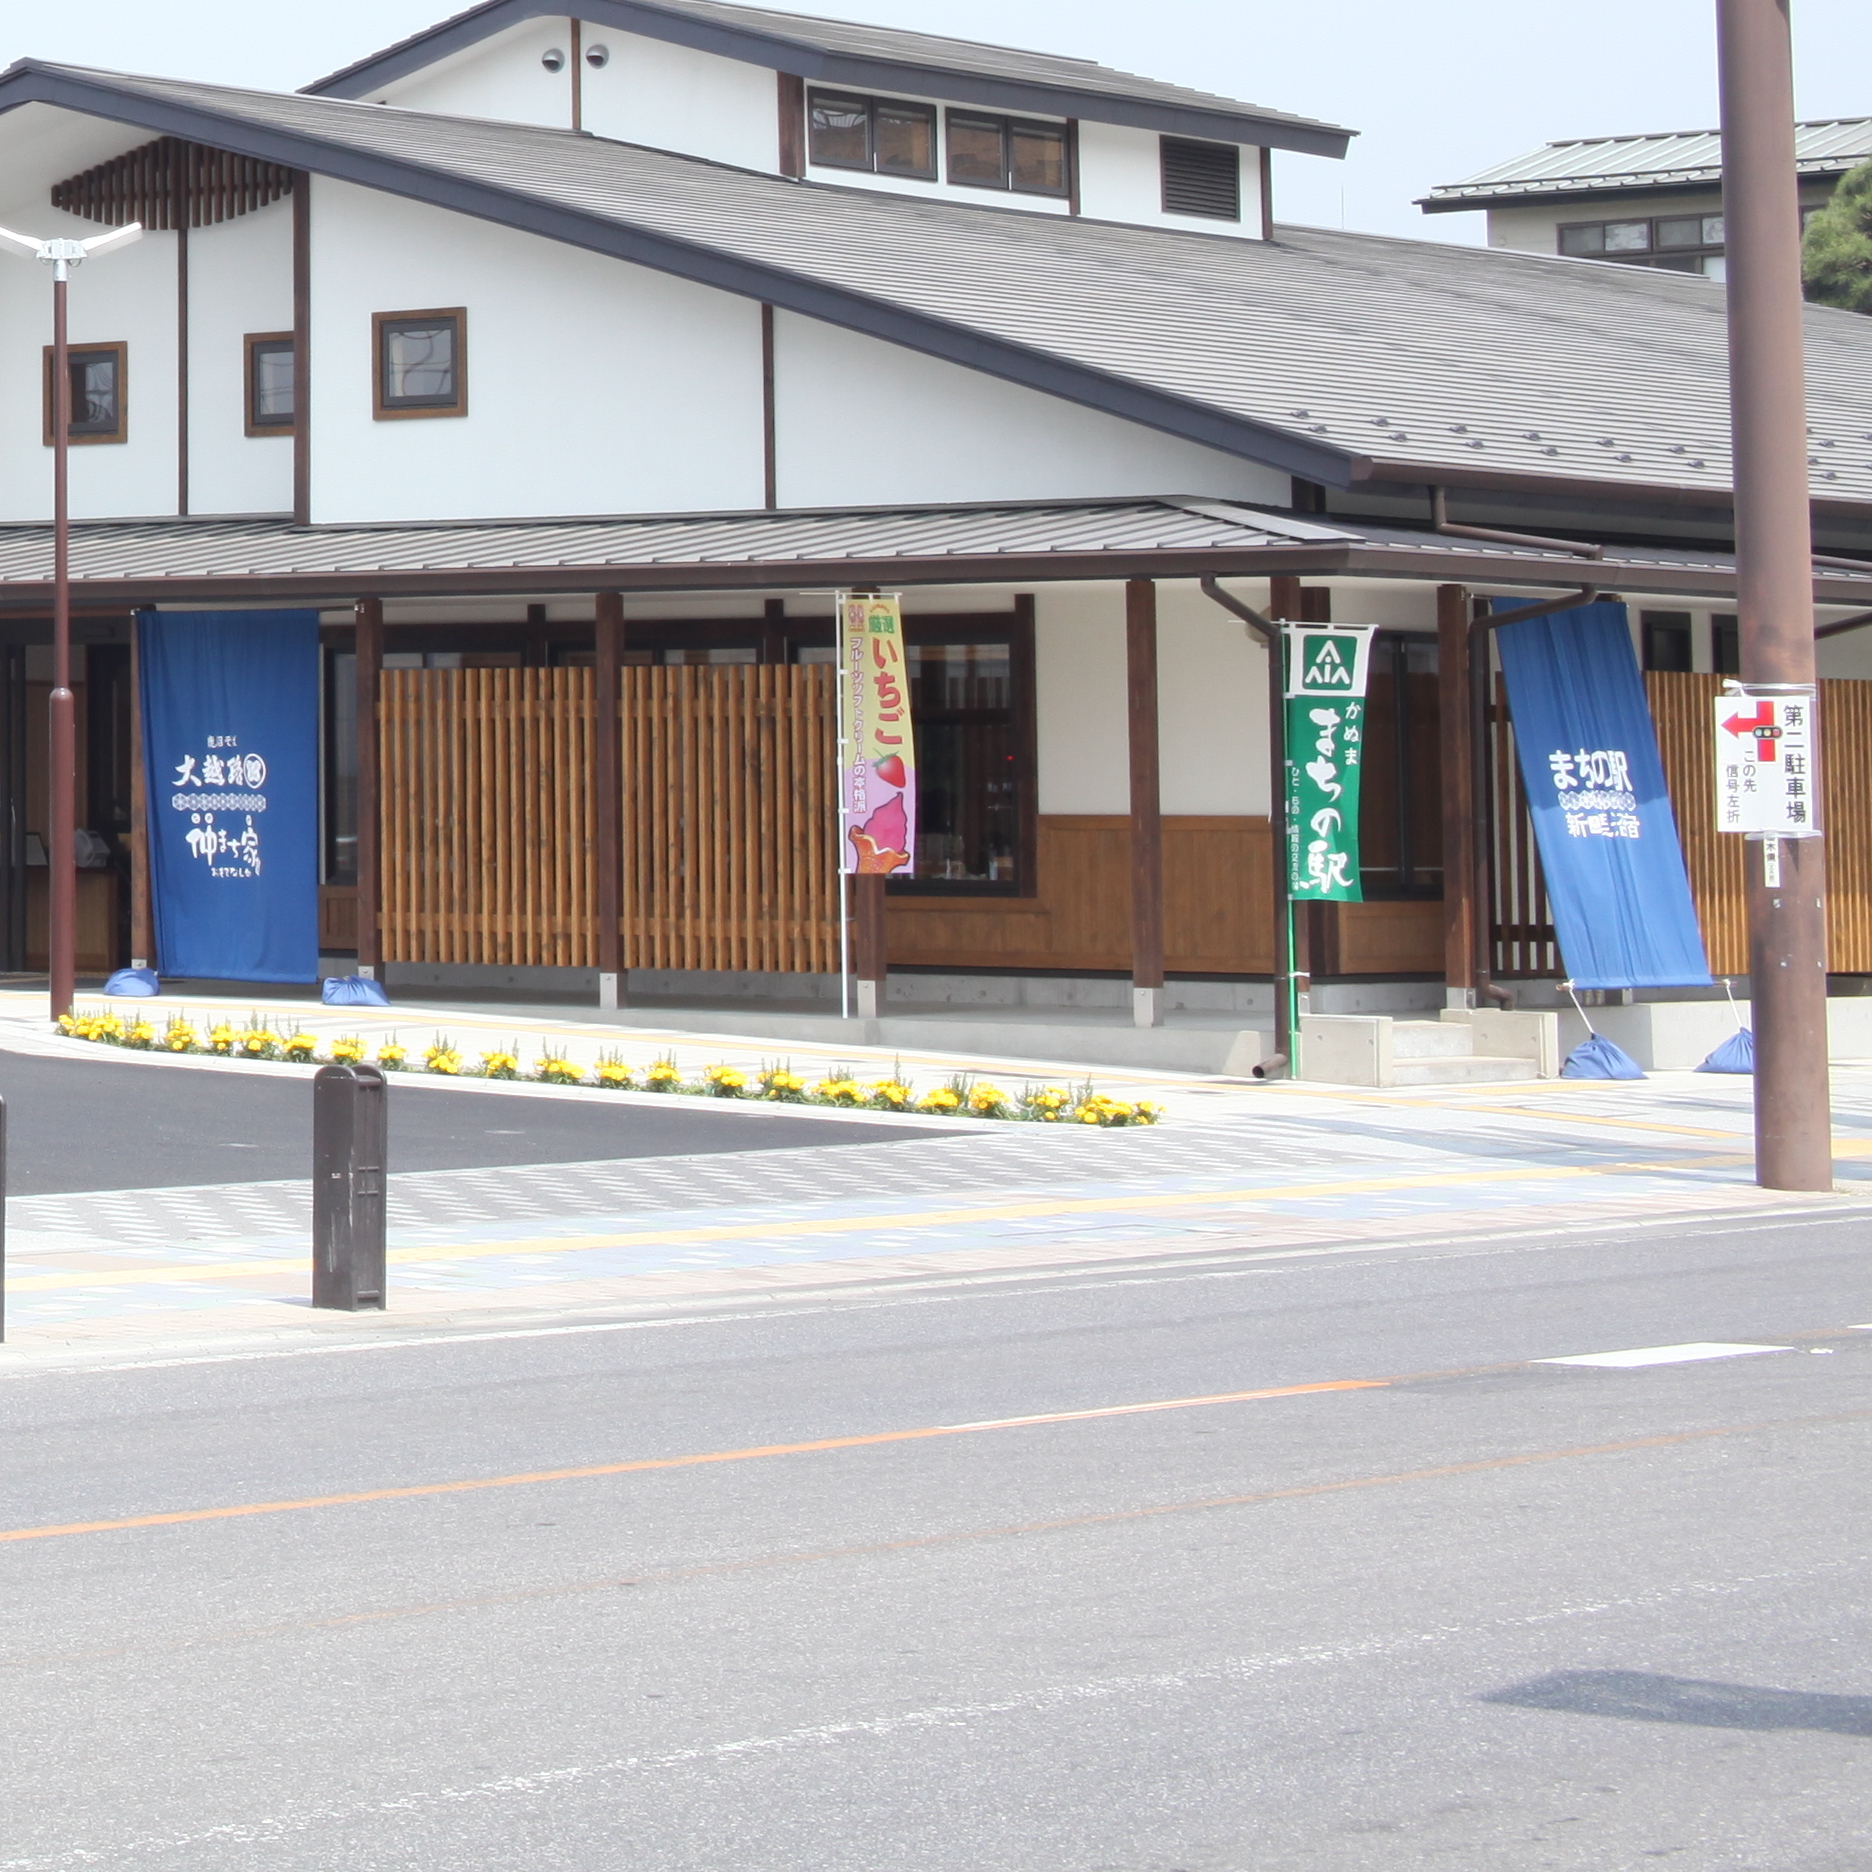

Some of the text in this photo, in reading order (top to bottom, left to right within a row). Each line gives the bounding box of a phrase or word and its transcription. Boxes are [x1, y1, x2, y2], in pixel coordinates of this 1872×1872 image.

[850, 636, 867, 814] フルーツソフトクリームの本格派
[872, 636, 906, 745] いちご
[1343, 701, 1362, 765] かぬま
[1299, 708, 1354, 894] まちの駅
[1548, 748, 1633, 792] まちの駅
[1726, 764, 1741, 823] 信号左折
[1743, 750, 1757, 793] この先
[1784, 704, 1806, 823] 第二駐車場
